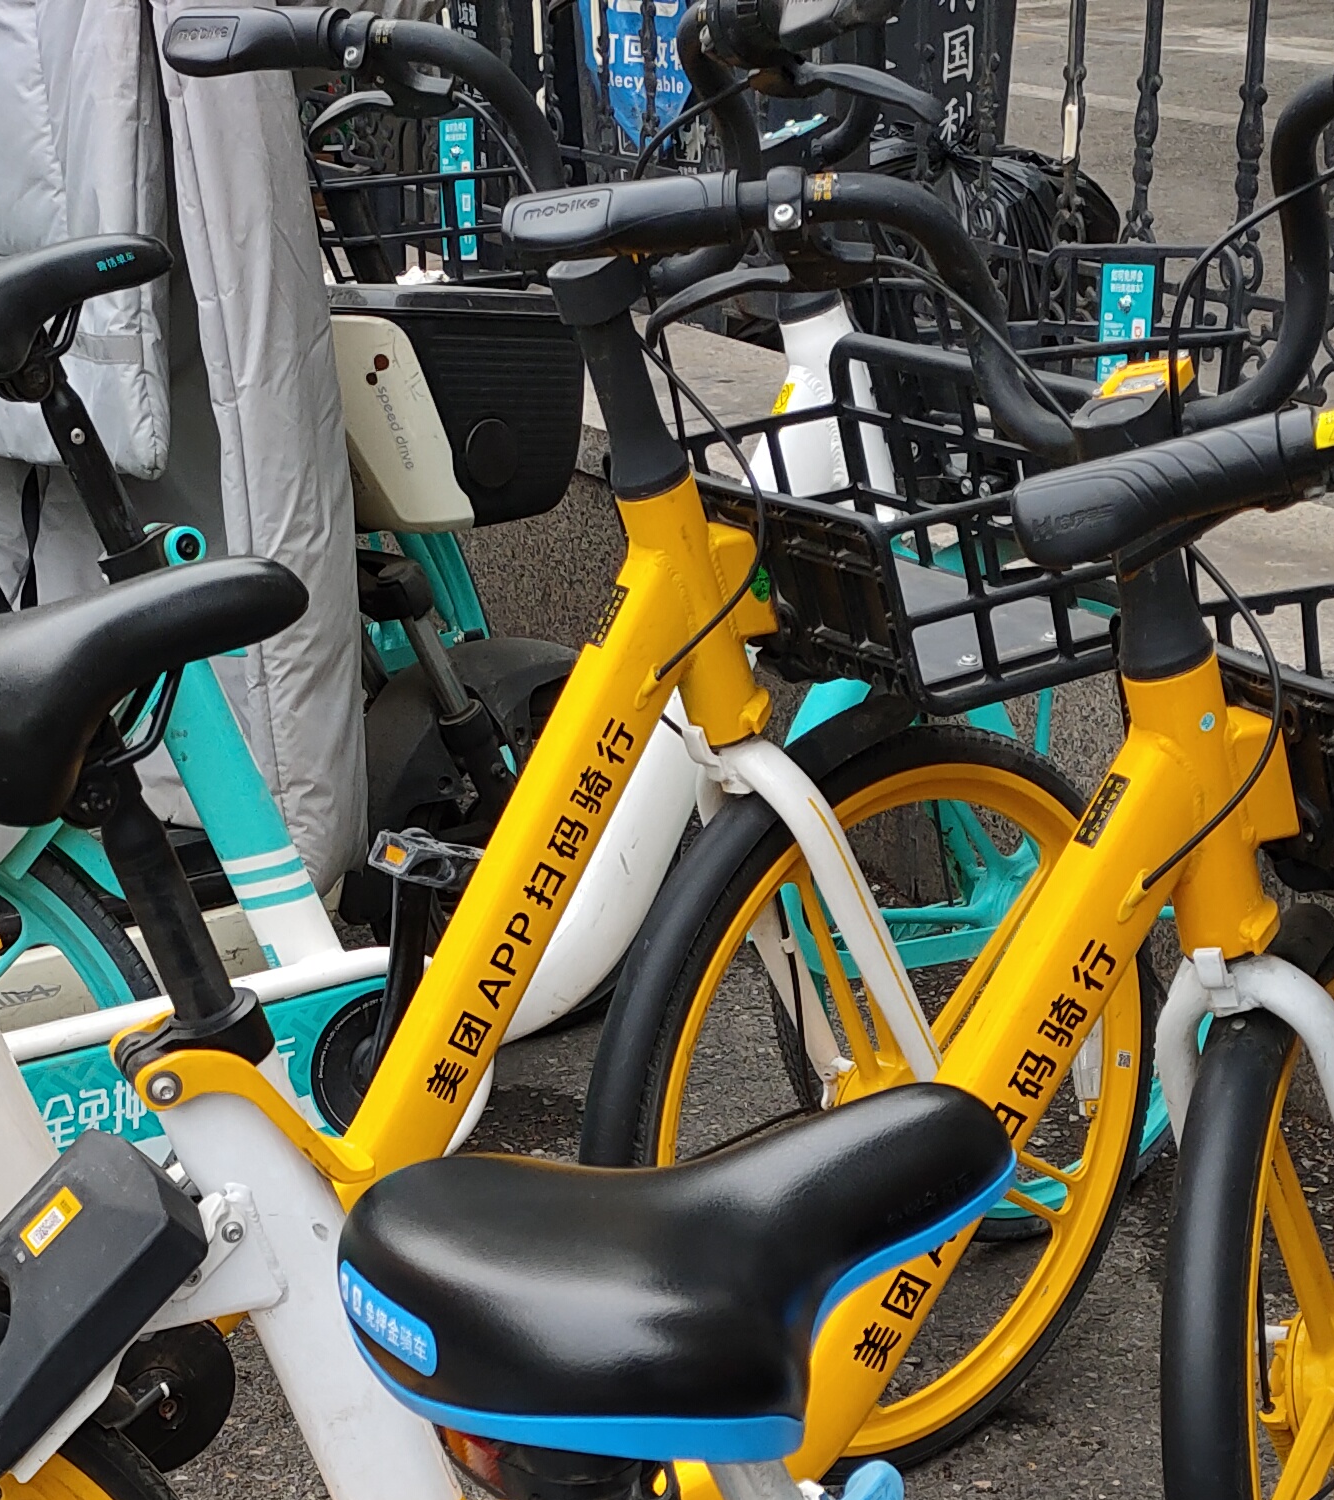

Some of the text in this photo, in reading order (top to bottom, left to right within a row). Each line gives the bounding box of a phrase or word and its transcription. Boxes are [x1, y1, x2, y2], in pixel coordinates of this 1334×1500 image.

[608, 69, 684, 94] ecyable
[522, 198, 600, 221] mobike
[376, 386, 414, 469] speed drive
